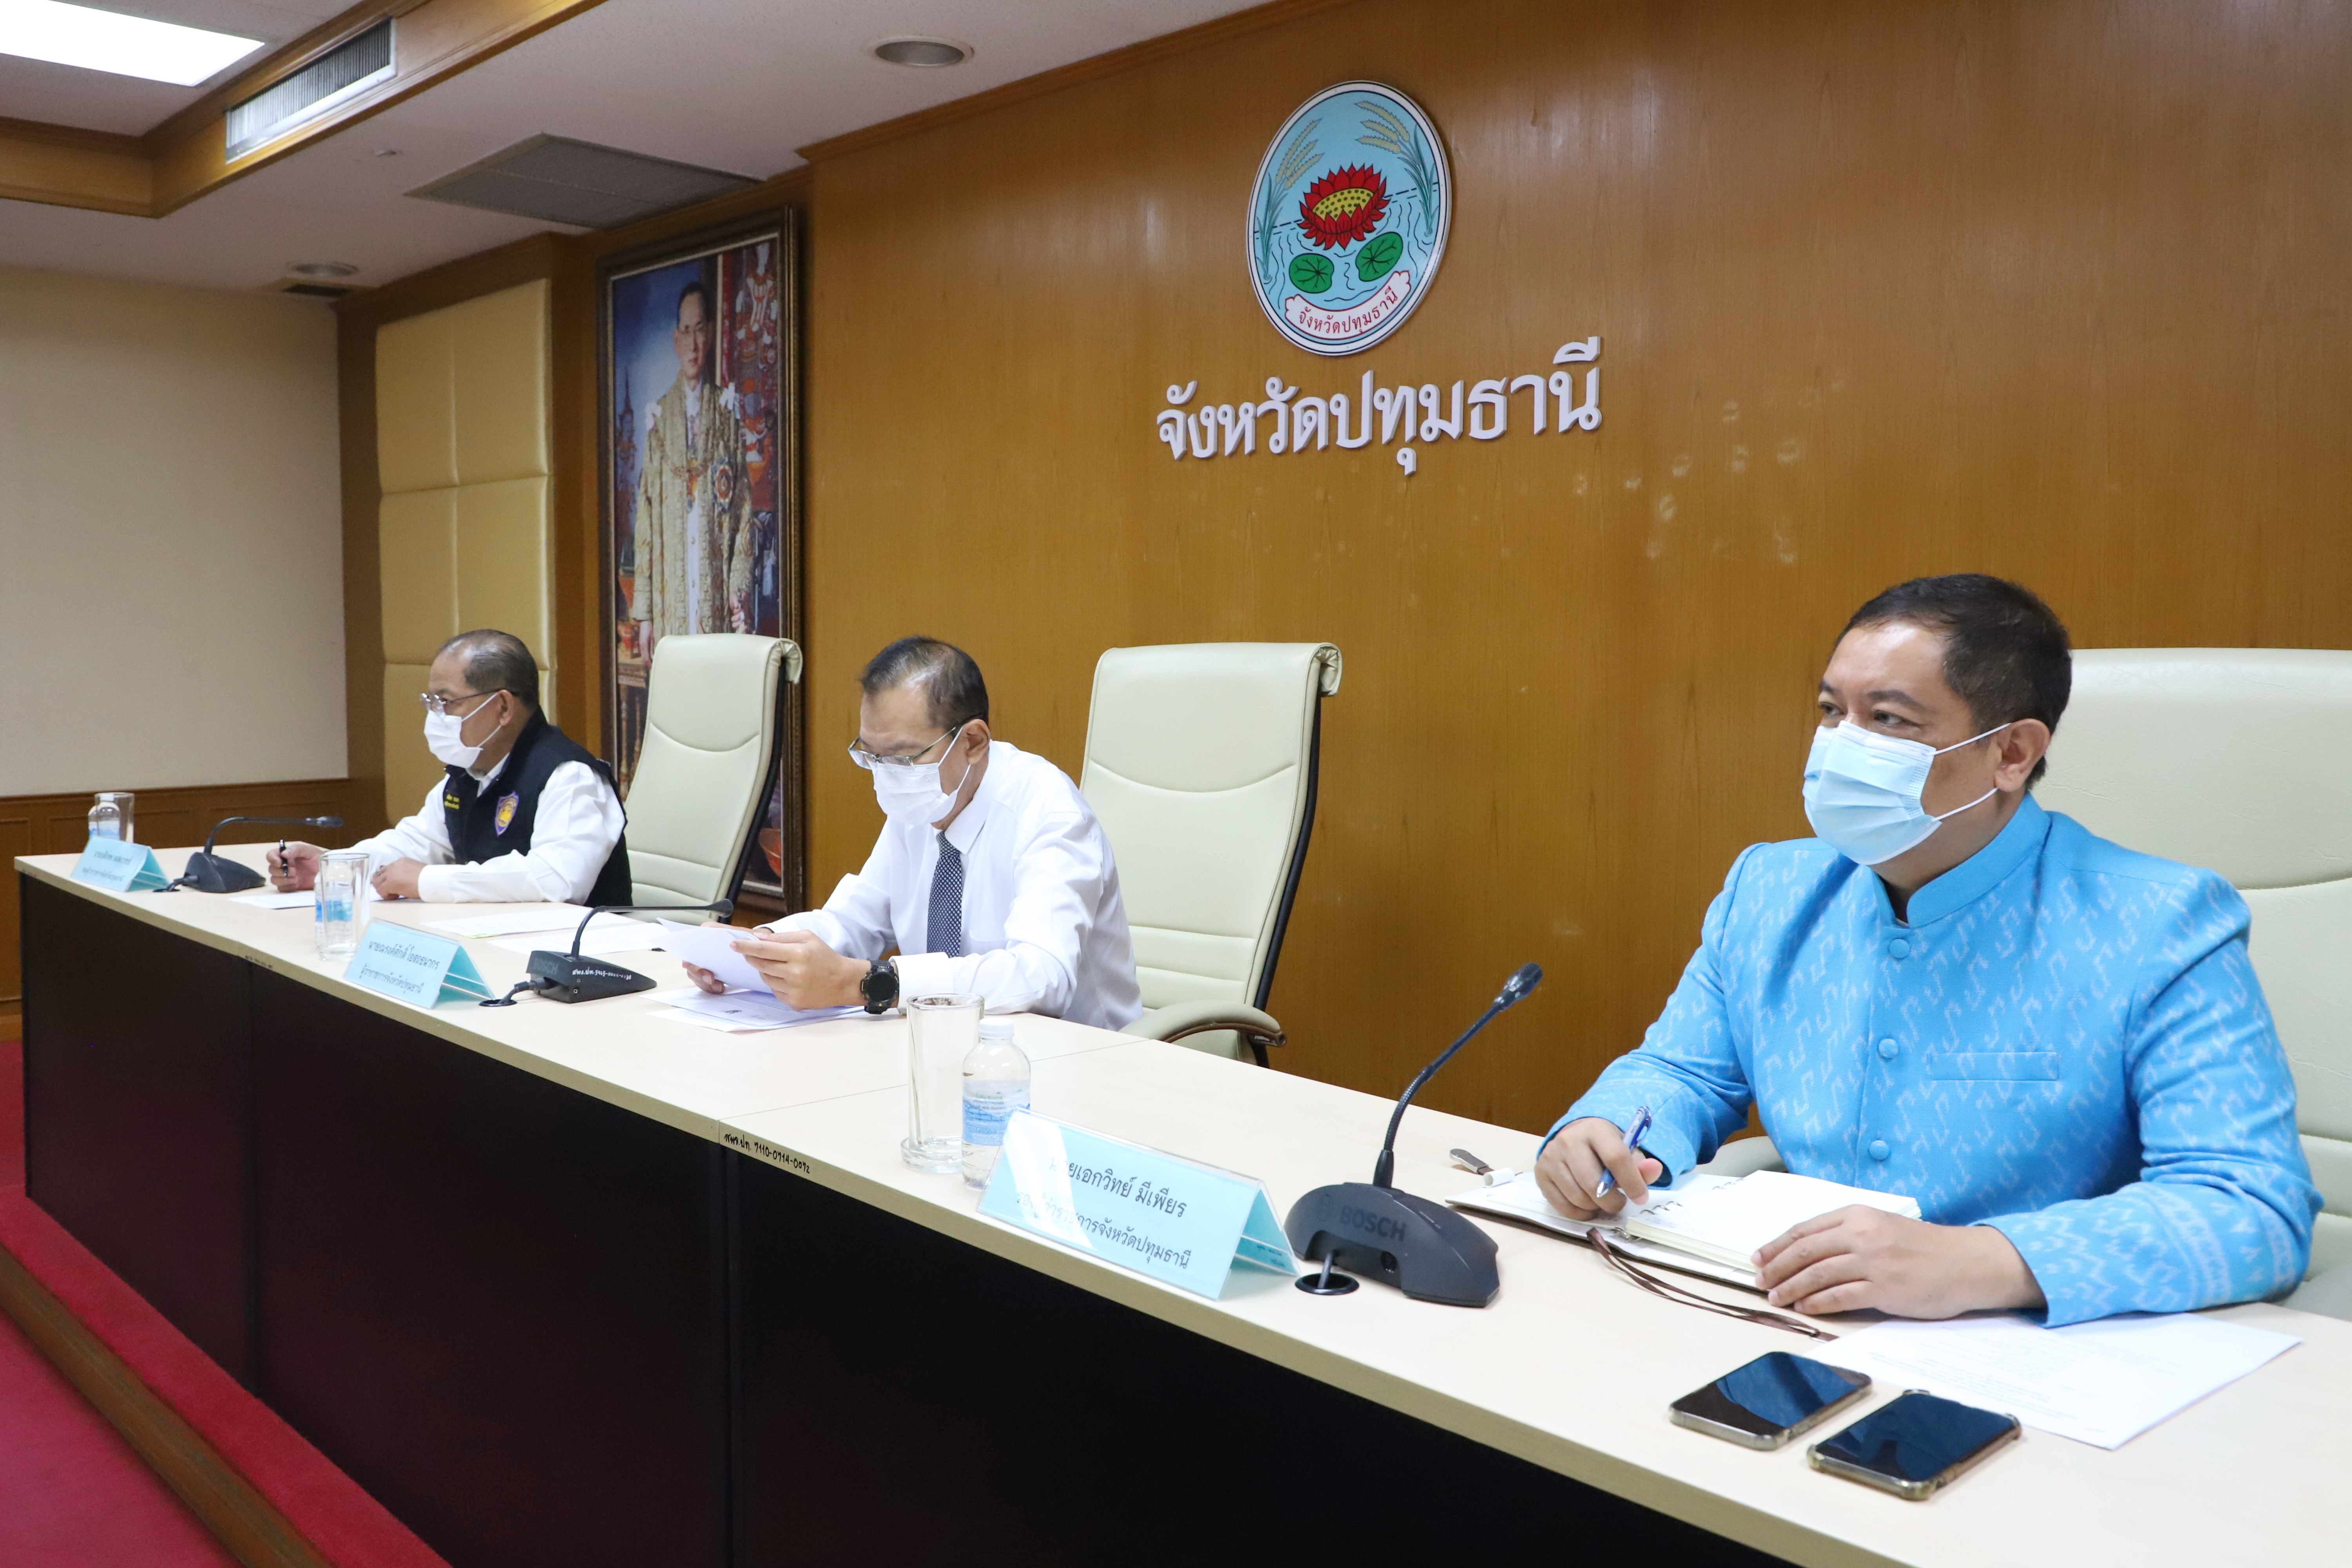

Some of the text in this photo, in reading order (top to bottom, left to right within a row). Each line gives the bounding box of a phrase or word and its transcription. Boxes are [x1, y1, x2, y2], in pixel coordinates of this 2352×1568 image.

[1299, 287, 1398, 333] จังหวัดปทุมธานี
[1156, 336, 1602, 475] จังหวัดปทุมธานี
[1135, 1181, 1187, 1218] มีเพียร
[1338, 1204, 1406, 1242] BOSCH
